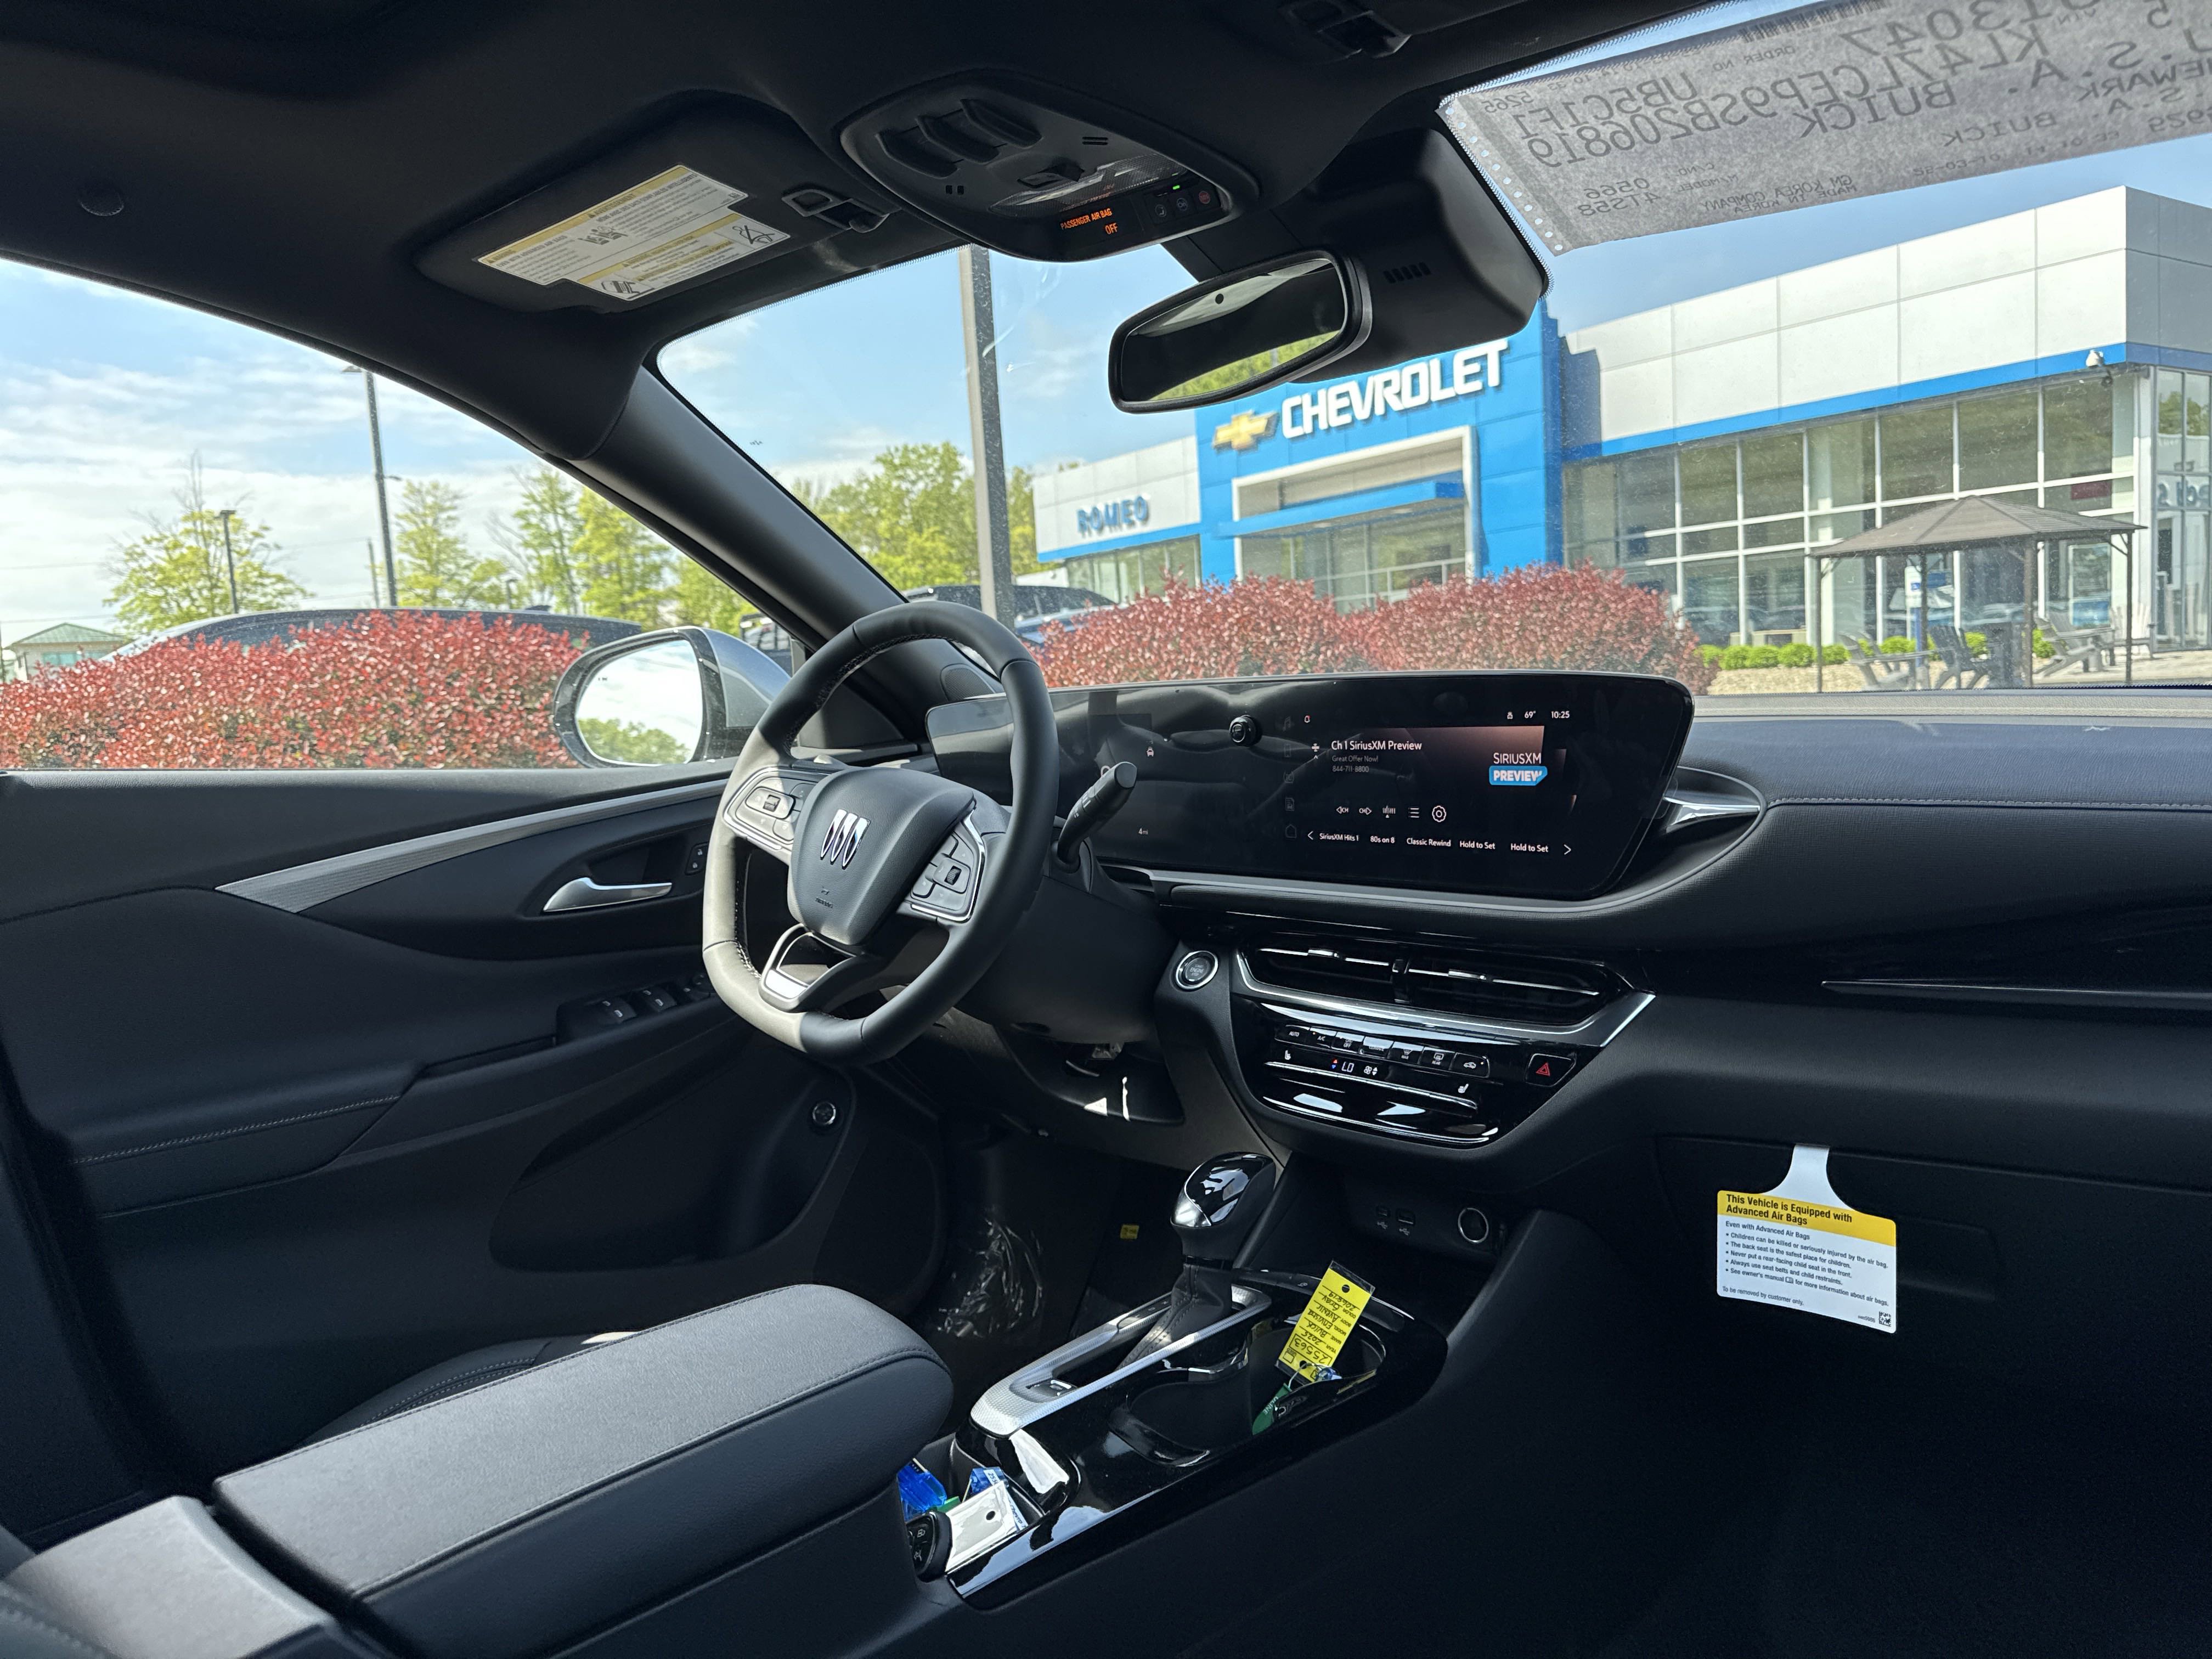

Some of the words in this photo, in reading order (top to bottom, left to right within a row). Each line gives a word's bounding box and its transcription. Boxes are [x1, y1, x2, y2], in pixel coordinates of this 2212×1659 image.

[1060, 215, 1091, 230] PASSENGER
[1091, 210, 1101, 221] AIR
[1101, 207, 1113, 218] BAG
[1105, 222, 1119, 235] OFF
[1281, 338, 1509, 439] CHEVROLET
[1077, 496, 1149, 535] ROMEO
[1551, 710, 1570, 719] 10:25
[1331, 740, 1343, 751] Ch
[1344, 740, 1348, 751] 1
[1350, 740, 1386, 751] SiriusXM
[1388, 740, 1422, 751] Preview
[1493, 770, 1543, 782] PREVIEW
[1319, 833, 1344, 841] SiriusXM
[1406, 838, 1427, 846] Classic
[1485, 842, 1496, 850] Set
[1510, 843, 1527, 851] Hold
[1726, 1194, 1745, 1204] This
[1747, 1197, 1779, 1210] Vehicle
[1781, 1201, 1788, 1211] is
[1791, 1204, 1831, 1219] Equipped
[1833, 1212, 1852, 1223] with
[1726, 1204, 1769, 1218] Advanced
[1771, 1210, 1785, 1221] Air
[1786, 1214, 1808, 1226] Bags
[1741, 1222, 1755, 1231] with
[1756, 1224, 1785, 1235] Advanced
[1795, 1232, 1810, 1241] Bags
[1731, 1232, 1754, 1241] Children
[1776, 1239, 1792, 1248] killed
[1800, 1245, 1826, 1255] seriously
[1827, 1249, 1847, 1259] injured
[1876, 1260, 1889, 1269] bag.
[1763, 1256, 1793, 1267] rear-facing
[1837, 1269, 1852, 1278] front.
[1785, 1250, 1802, 1259] safest
[1803, 1254, 1818, 1262] place
[1827, 1259, 1852, 1269] children.
[1730, 1259, 1750, 1268] Always
[1801, 1271, 1814, 1279] child
[1815, 1273, 1843, 1286] restraints.
[1742, 1270, 1764, 1279] owner's
[1764, 1274, 1785, 1283] manual
[1819, 1283, 1849, 1296] information
[1850, 1291, 1865, 1300] about
[1875, 1297, 1889, 1307] bags.
[1328, 1290, 1357, 1312] 206819
[1737, 1289, 1759, 1297] removed
[1768, 1294, 1791, 1303] customer
[1792, 1298, 1804, 1306] only.
[1342, 1308, 1357, 1319] COLOR
[1333, 1326, 1347, 1336] MODEL
[1340, 1318, 1352, 1328] BODY
[1300, 1330, 1323, 1344] 2025
[1330, 1335, 1342, 1345] MAKE
[1294, 1338, 1329, 1364] 25563
[1325, 1345, 1336, 1355] YEAR
[1262, 1396, 1279, 1415] ULINE
